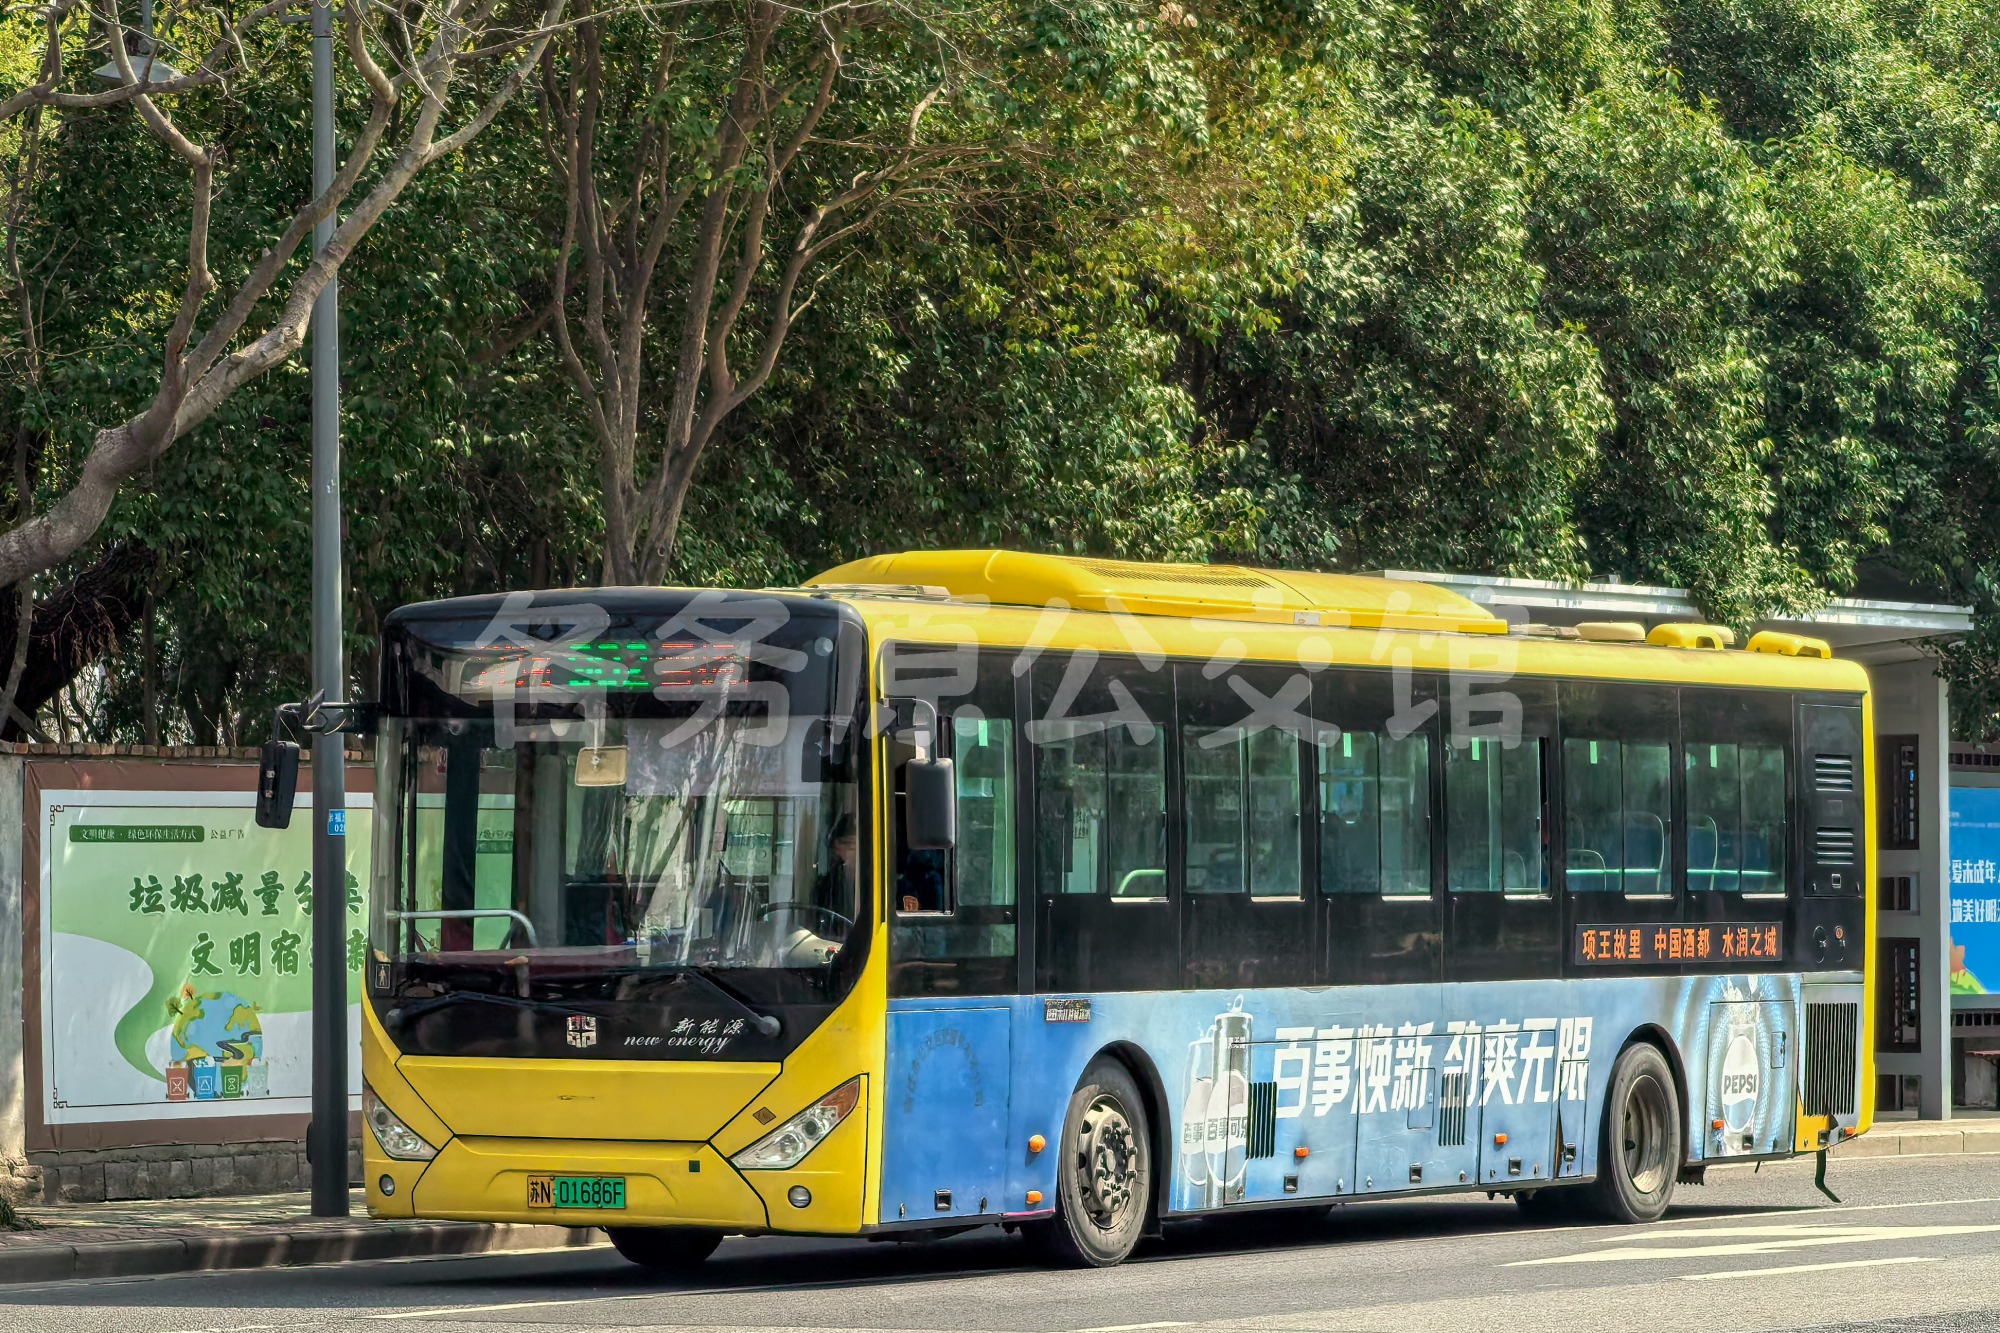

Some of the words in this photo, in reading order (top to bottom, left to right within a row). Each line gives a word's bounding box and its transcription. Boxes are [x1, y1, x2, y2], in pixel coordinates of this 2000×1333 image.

[210, 829, 246, 840] 公益广告
[1951, 859, 2000, 884] 爱未成年
[1951, 898, 2000, 923] 筑美好明
[190, 928, 368, 977] 文明宿新
[1582, 928, 1642, 960] 项王故里
[1654, 927, 1711, 959] 中国酒都
[1722, 926, 1777, 958] 水润之城
[671, 1018, 745, 1036] 新能源
[624, 1036, 663, 1047] new
[668, 1036, 732, 1055] energy
[1274, 1021, 1434, 1119] 百事焕新
[1439, 1016, 1593, 1109] 劲爽无限
[1723, 1073, 1758, 1095] PEPSI
